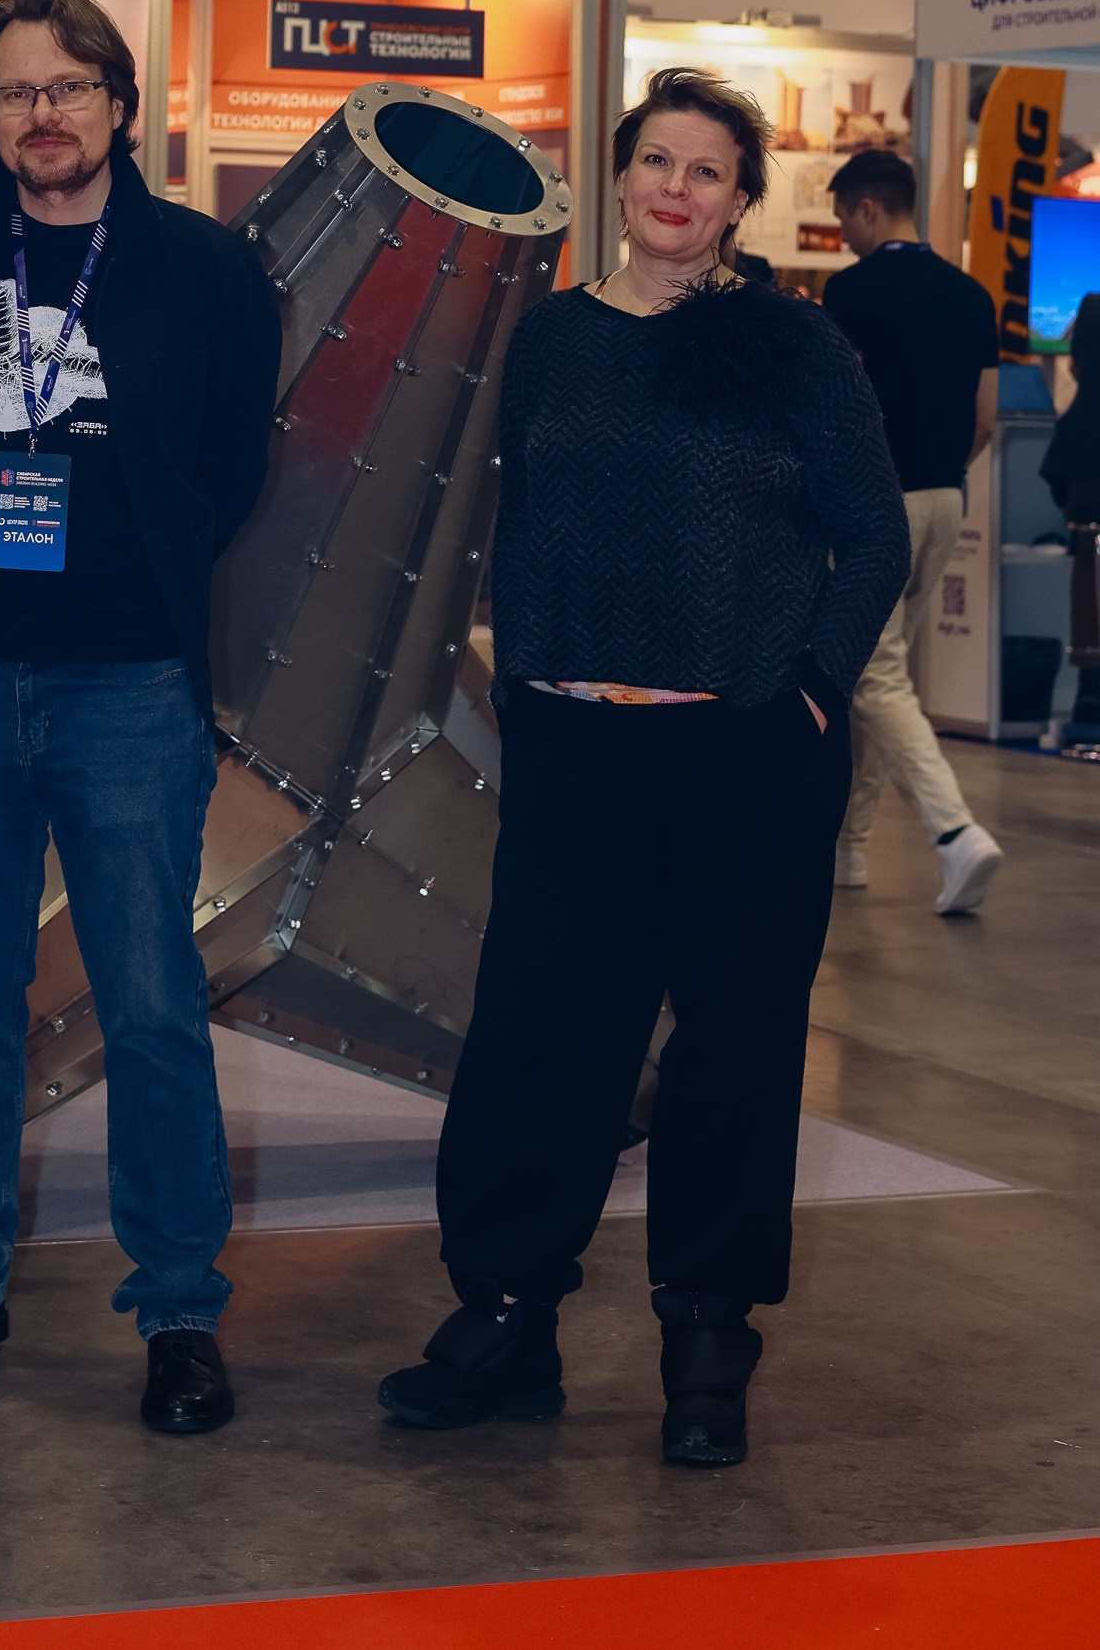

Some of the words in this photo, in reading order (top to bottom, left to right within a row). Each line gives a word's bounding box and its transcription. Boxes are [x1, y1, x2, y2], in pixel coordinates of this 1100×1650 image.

[369, 31, 471, 47] СТРОИТЕЛЬНЫЕ
[369, 43, 471, 60] ТЕХНОЛОГИИ
[212, 112, 311, 130] ТЕХНОЛОГИИ
[3, 531, 54, 544] ЭТАЛОН
